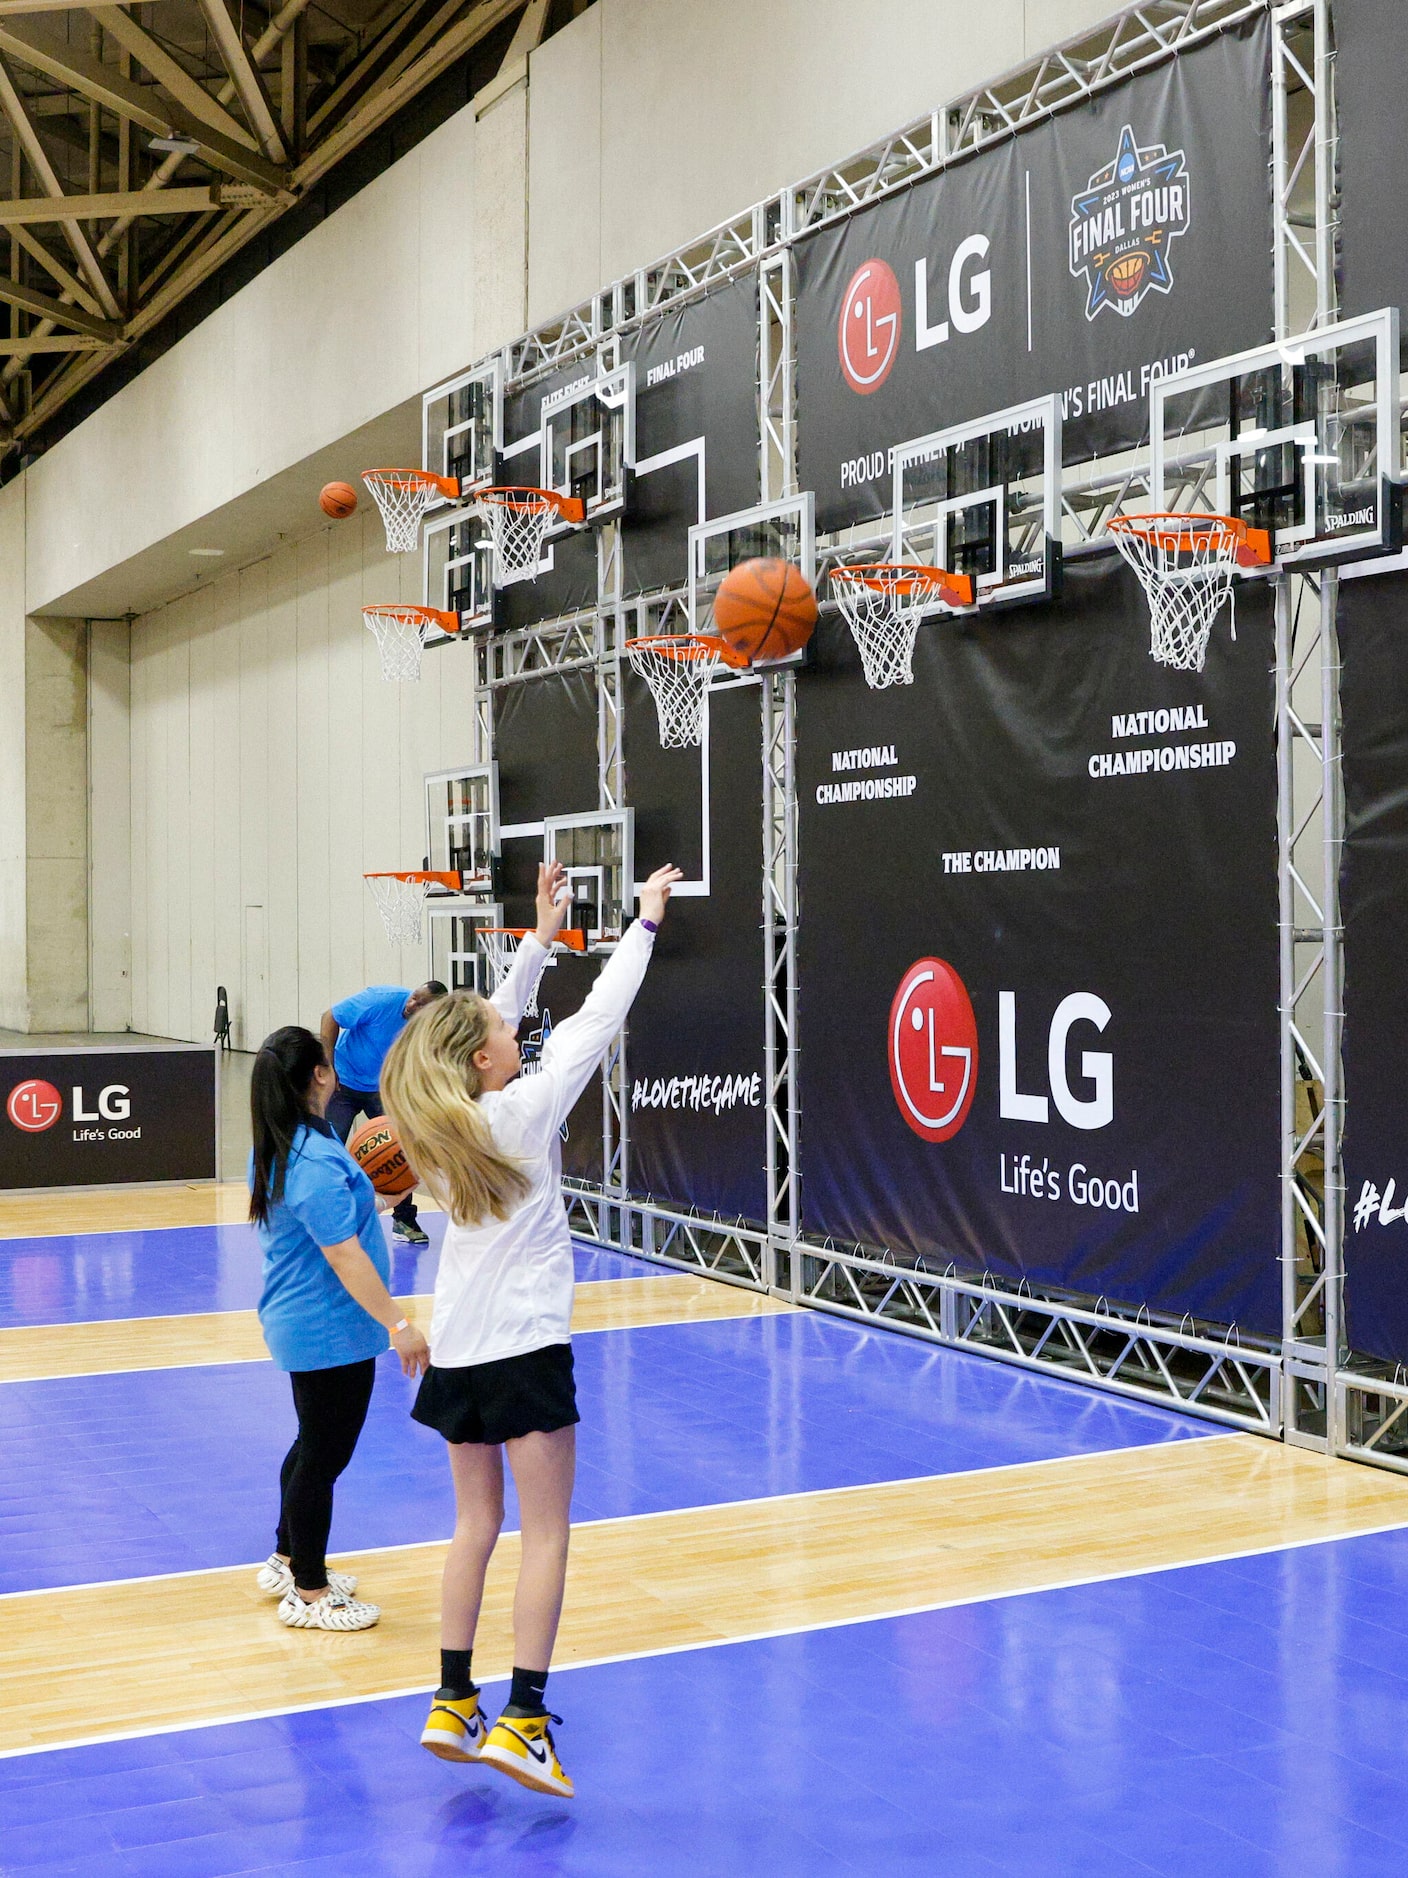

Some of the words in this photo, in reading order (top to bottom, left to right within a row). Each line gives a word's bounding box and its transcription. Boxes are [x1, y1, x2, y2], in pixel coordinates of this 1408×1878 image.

[1103, 191, 1120, 205] 2023
[1121, 177, 1151, 197] WOMEN'S
[1073, 202, 1126, 263] FINAL
[1130, 185, 1184, 231] FOUR
[1114, 237, 1141, 254] DALLAS
[915, 233, 992, 352] LG
[646, 359, 676, 387] FINAL
[676, 345, 705, 373] FOUR
[841, 451, 885, 488] PROUD
[1087, 370, 1137, 414] FINAL
[1324, 505, 1375, 533] SPALDING
[1009, 557, 1043, 579] SPALDING
[1111, 704, 1209, 739] NATIONAL
[831, 744, 899, 771] NATIONAL
[1088, 740, 1237, 778] CHAMPIONSHIP
[815, 775, 917, 805] CHAMPIONSHIP
[941, 852, 972, 873] THE
[973, 847, 1061, 872] CHAMPION
[998, 990, 1114, 1130] LG
[72, 1084, 131, 1122] LG
[631, 1071, 762, 1116] #LOVETHEGAME
[73, 1129, 105, 1142] Life's
[108, 1126, 141, 1140] Good
[354, 1128, 394, 1161] NCAA
[1000, 1153, 1061, 1201] Life's
[1068, 1163, 1139, 1213] Good
